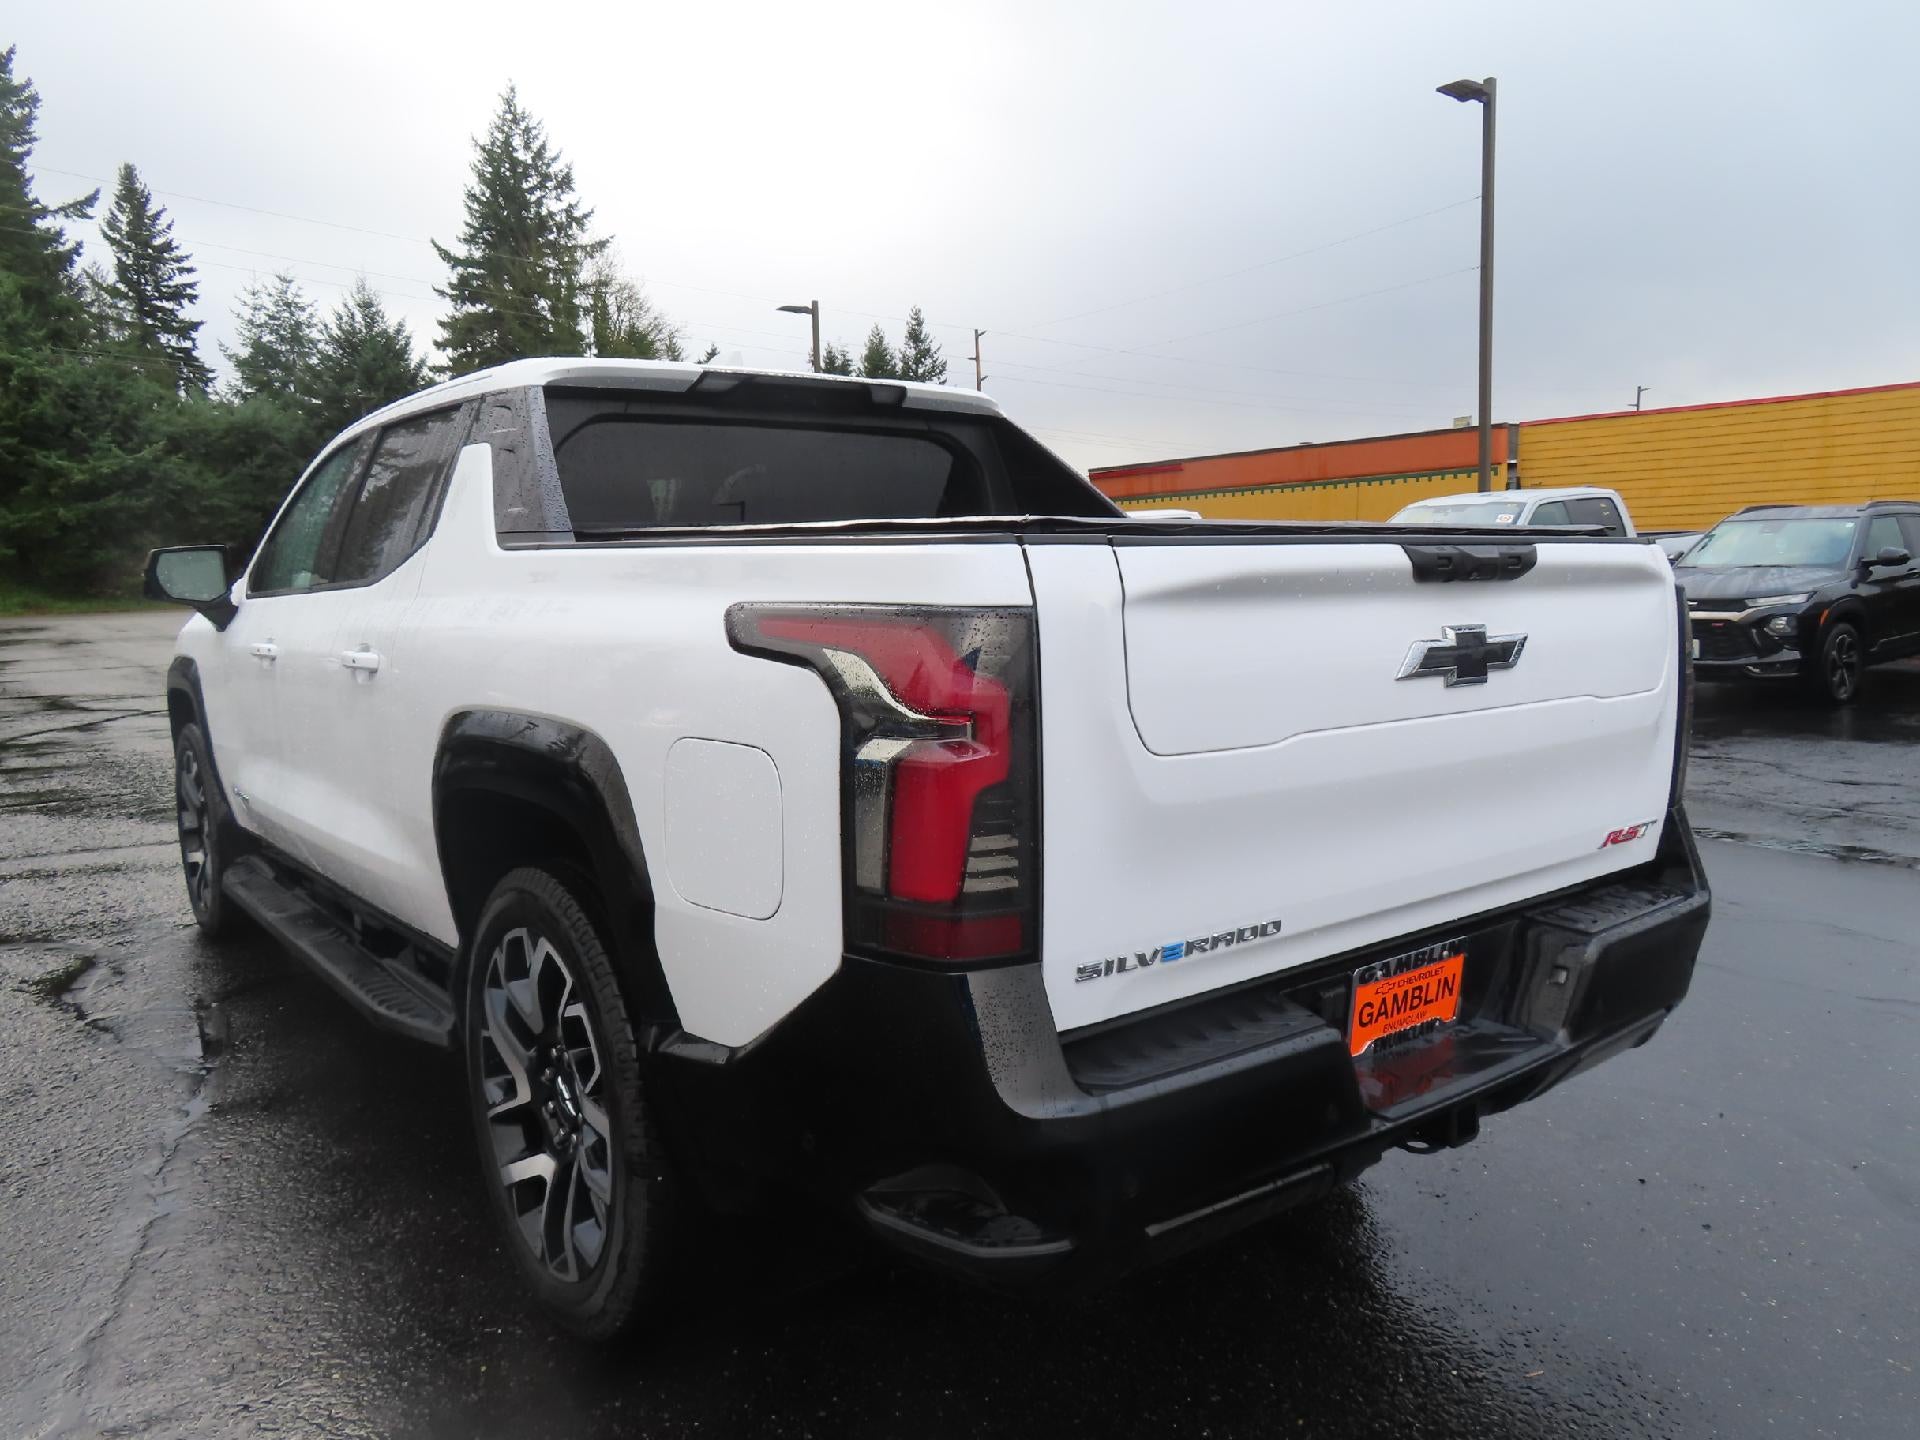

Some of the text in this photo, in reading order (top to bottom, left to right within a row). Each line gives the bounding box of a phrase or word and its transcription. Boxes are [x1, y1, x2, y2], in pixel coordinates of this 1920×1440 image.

[1597, 819, 1658, 850] RST
[1075, 920, 1281, 983] SILVERADO
[1397, 966, 1445, 988] CHEVROLET
[1358, 973, 1456, 1028] GAMBLIN
